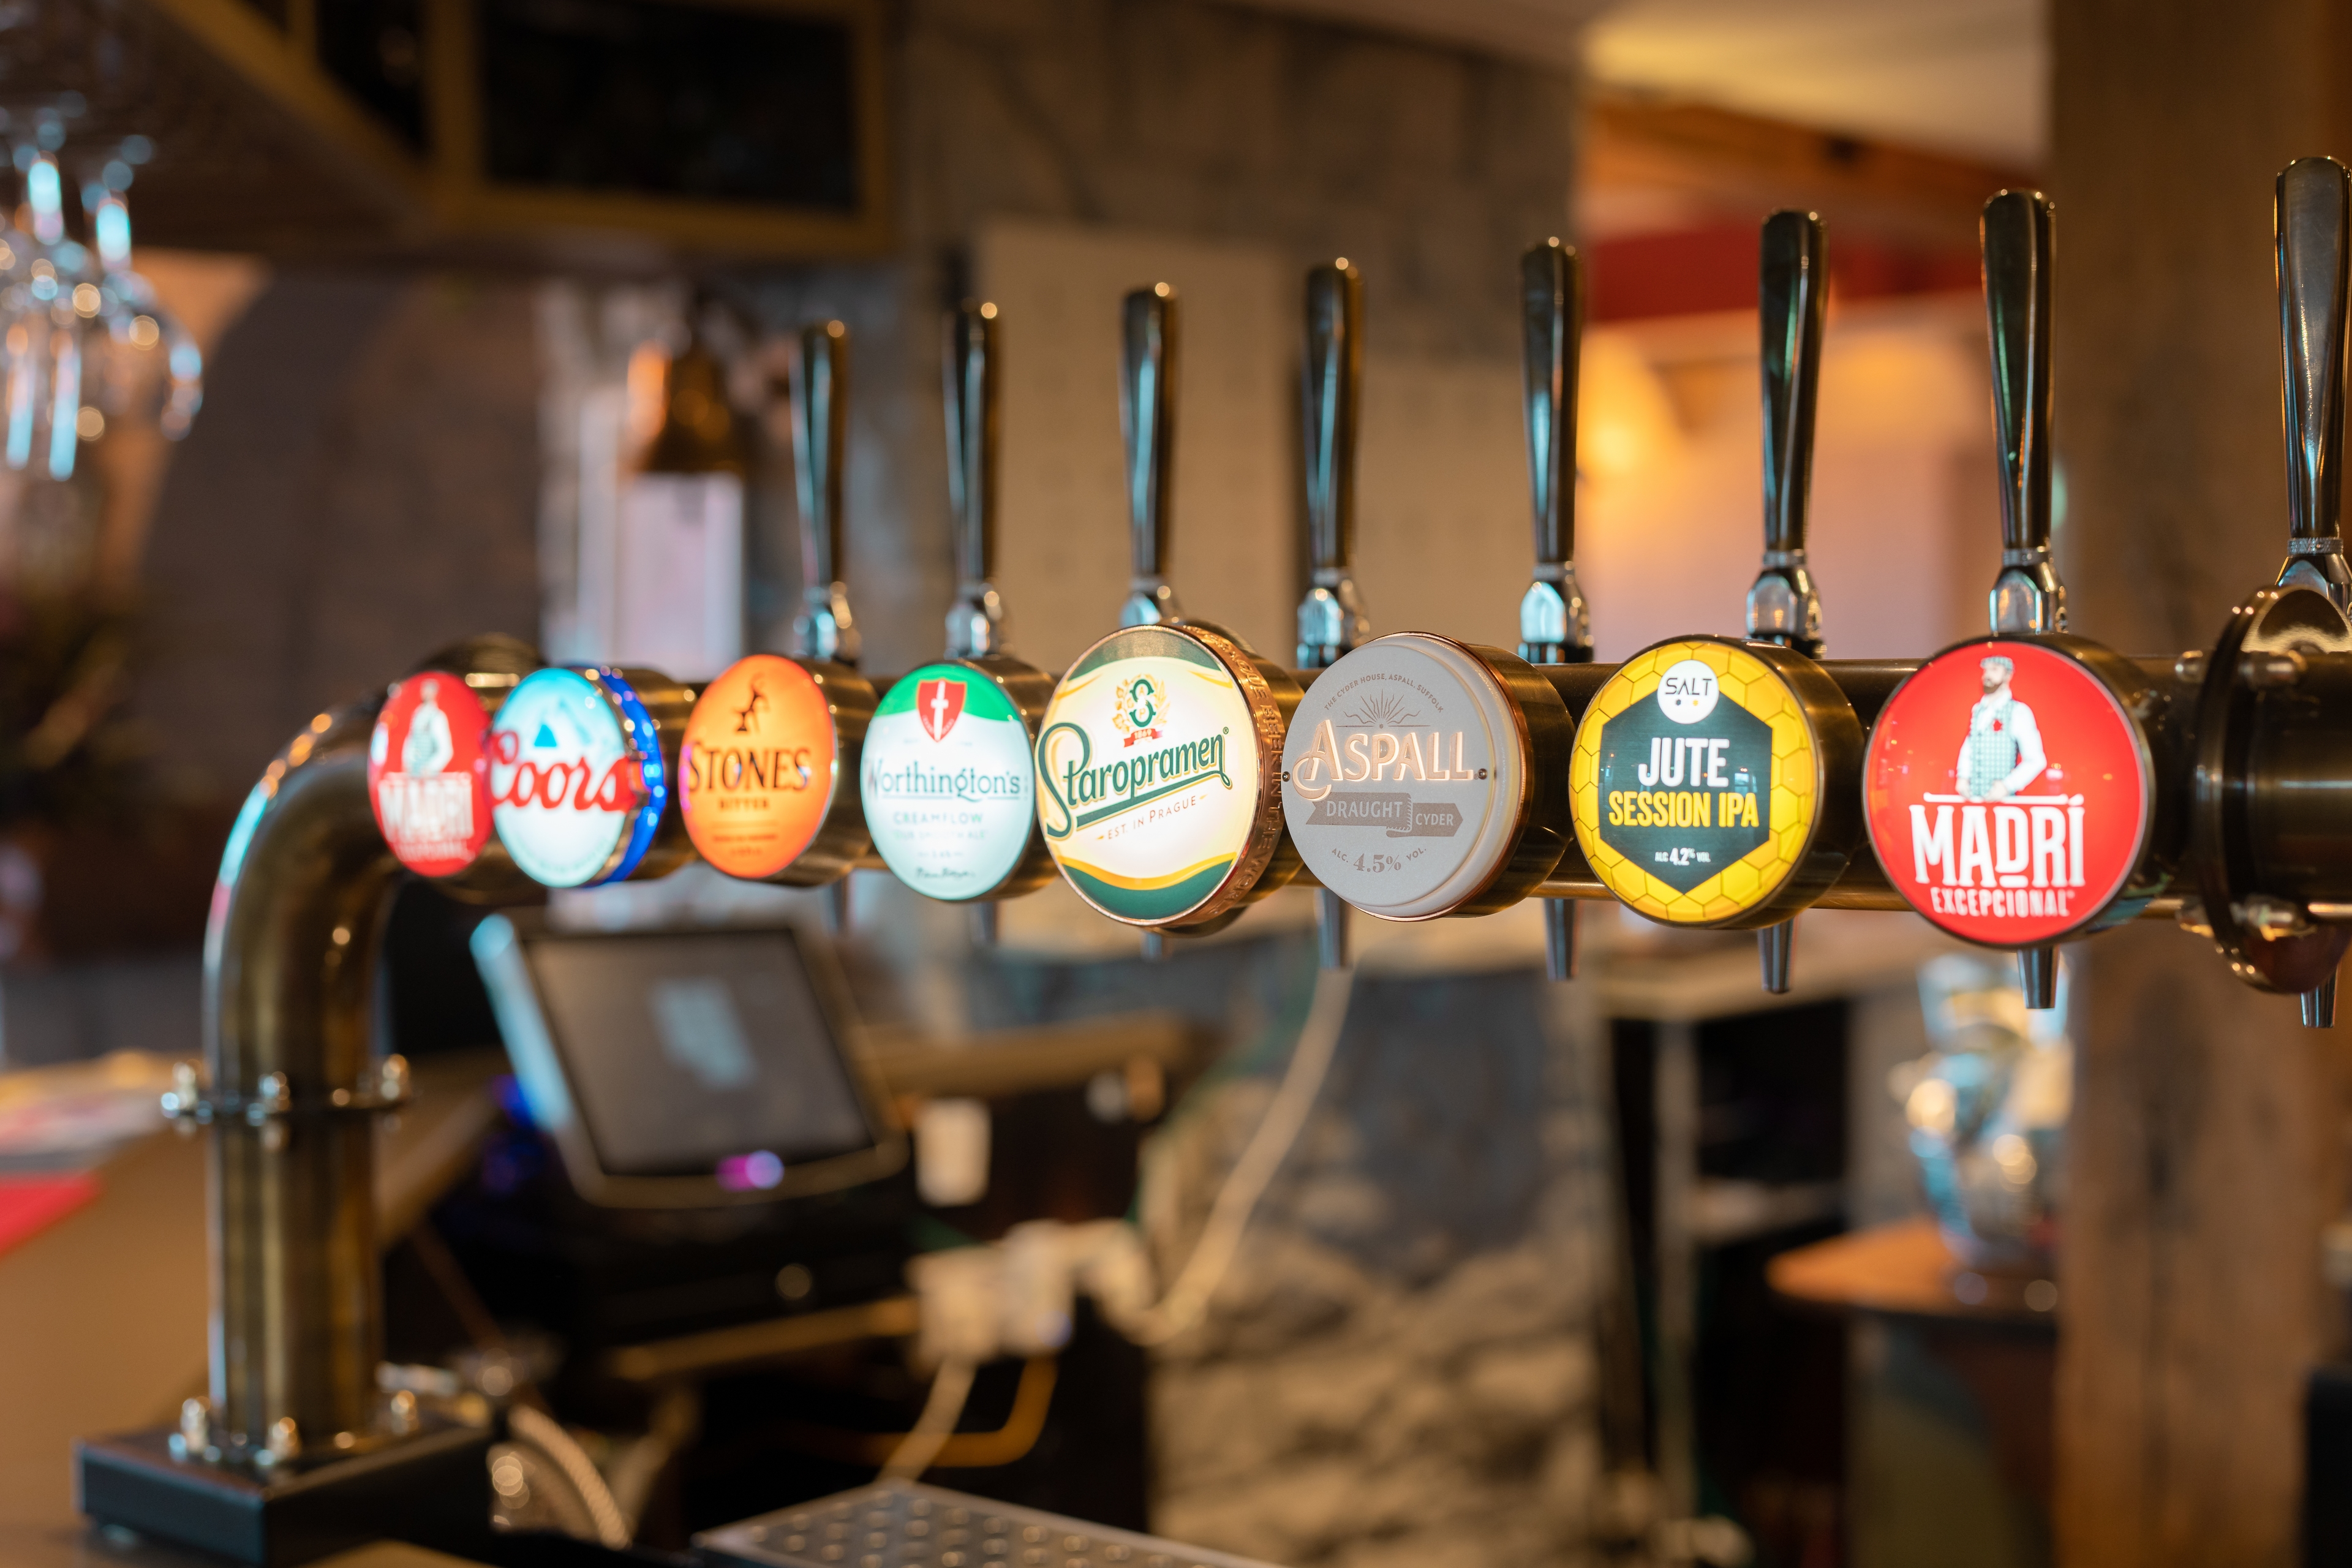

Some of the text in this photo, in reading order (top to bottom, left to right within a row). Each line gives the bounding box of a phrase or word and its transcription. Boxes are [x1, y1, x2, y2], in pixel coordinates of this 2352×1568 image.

[1324, 673, 1444, 714] THE CYDER HOUSE, ASPALL, SUFFOLK
[1664, 677, 1712, 696] SALT
[1134, 729, 1153, 739] 1869
[484, 729, 637, 815] Coors
[687, 741, 812, 794] STONES
[1292, 719, 1474, 801] ASPALL
[1637, 737, 1730, 788] JUTE
[1107, 795, 1196, 840] EST. IN PRAGUE
[1325, 800, 1454, 826] DRAUGHT CYDER
[1608, 791, 1760, 828] SESSION IPA
[1332, 847, 1427, 873] ALC. 4.5% VOL.
[1655, 851, 1669, 863] ALC
[1697, 851, 1711, 863] VOL
[1929, 886, 2070, 918] EXCEPCIONAL
